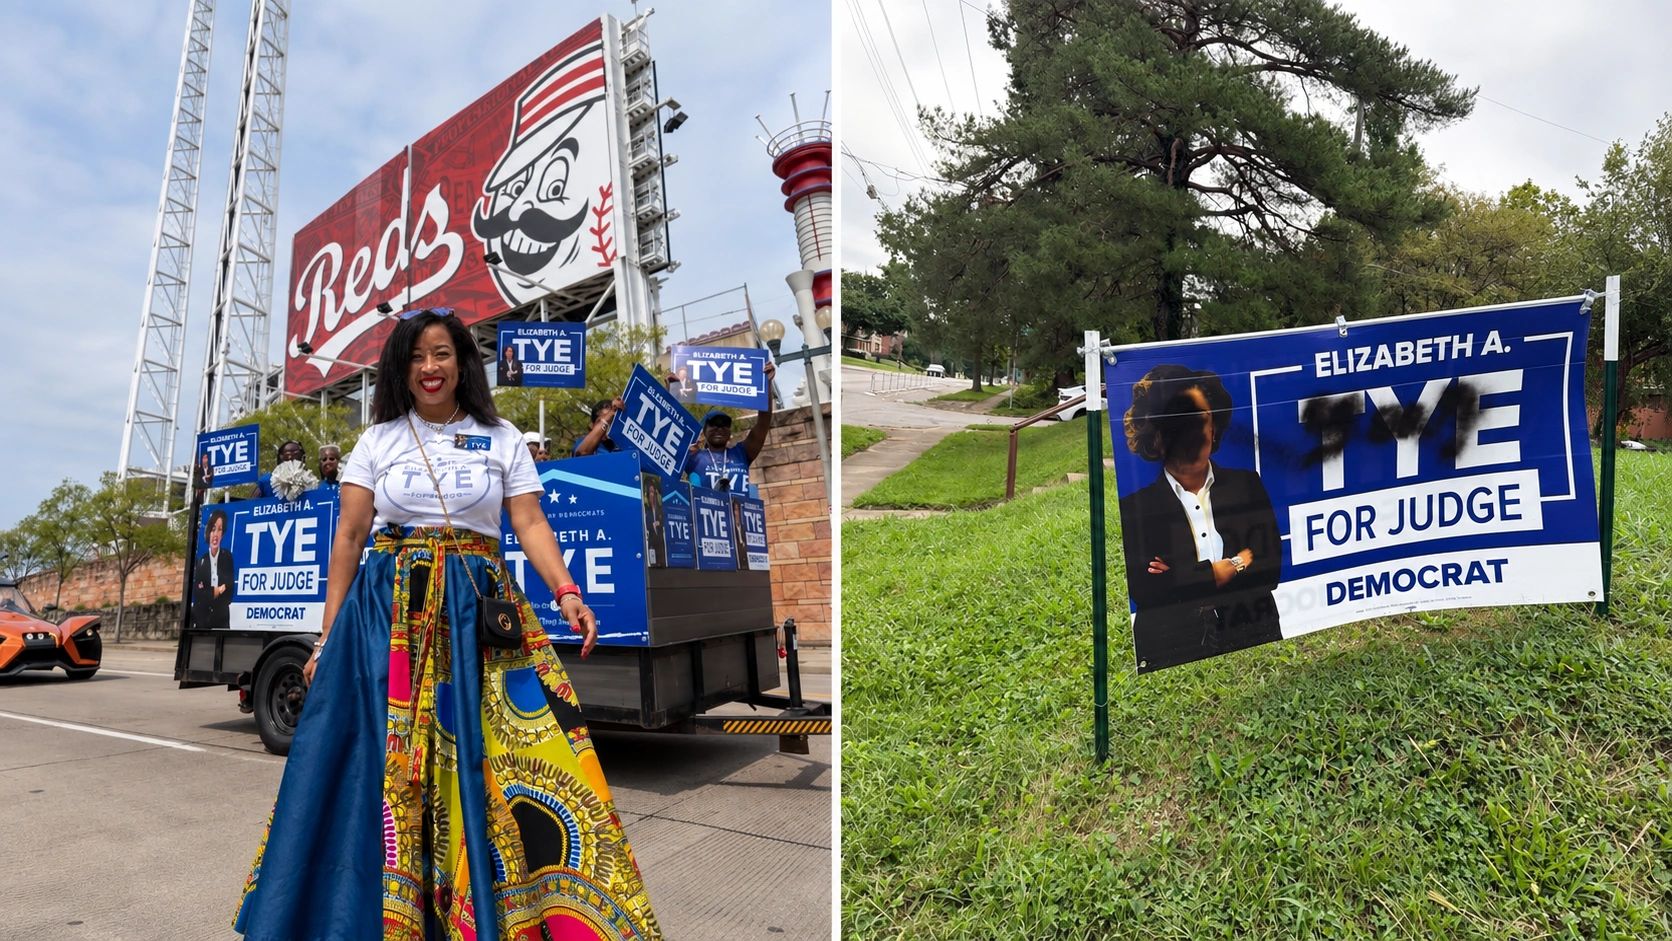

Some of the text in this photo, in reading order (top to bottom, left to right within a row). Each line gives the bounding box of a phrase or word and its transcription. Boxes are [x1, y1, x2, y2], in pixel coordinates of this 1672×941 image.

[288, 167, 464, 360] Reds
[512, 338, 571, 362] TYE
[1315, 330, 1511, 378] ELIZABETH A.
[525, 364, 570, 373] FOR JUDGE
[686, 360, 752, 384] TYE
[635, 392, 685, 456] TYE
[1297, 368, 1524, 492] TYE
[207, 440, 248, 466] TYE
[626, 423, 672, 470] FOR JUDGE
[402, 469, 473, 491] TYE
[253, 499, 314, 516] ELIZABETH A.
[1306, 504, 1376, 552] FOR
[1388, 483, 1523, 536] JUDGE
[668, 520, 690, 540] TYE
[700, 507, 728, 538] TYE
[743, 511, 763, 533] TYE
[245, 517, 318, 565] TYE
[505, 528, 612, 545] ELETH A.
[242, 571, 313, 591] FOR JUDGE
[504, 547, 615, 594] TE
[1326, 558, 1509, 606] DEMOCRAT
[246, 607, 306, 620] DEMOCRAT
